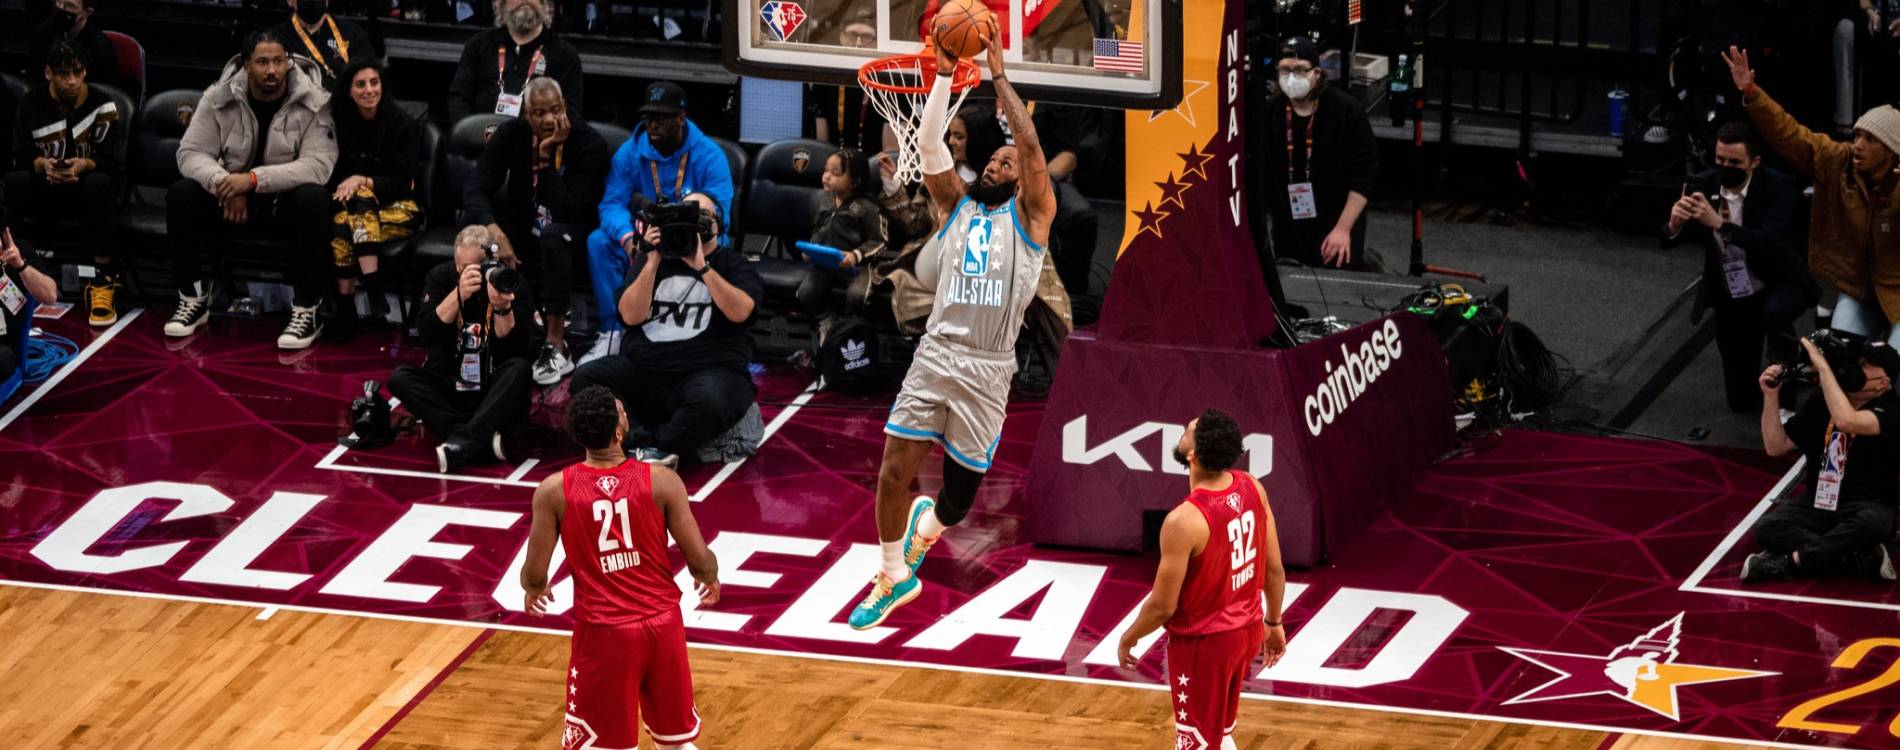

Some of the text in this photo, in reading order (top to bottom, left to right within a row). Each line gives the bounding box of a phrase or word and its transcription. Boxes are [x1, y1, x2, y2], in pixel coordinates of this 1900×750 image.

[1226, 28, 1241, 228] NBA TV
[947, 275, 1004, 307] ALL-STAR
[844, 357, 870, 370] adidas
[1303, 317, 1402, 437] coinbase
[592, 497, 634, 552] 21
[1227, 509, 1257, 571] 32
[599, 550, 641, 574] EMBIID
[1775, 636, 1900, 739] 2
